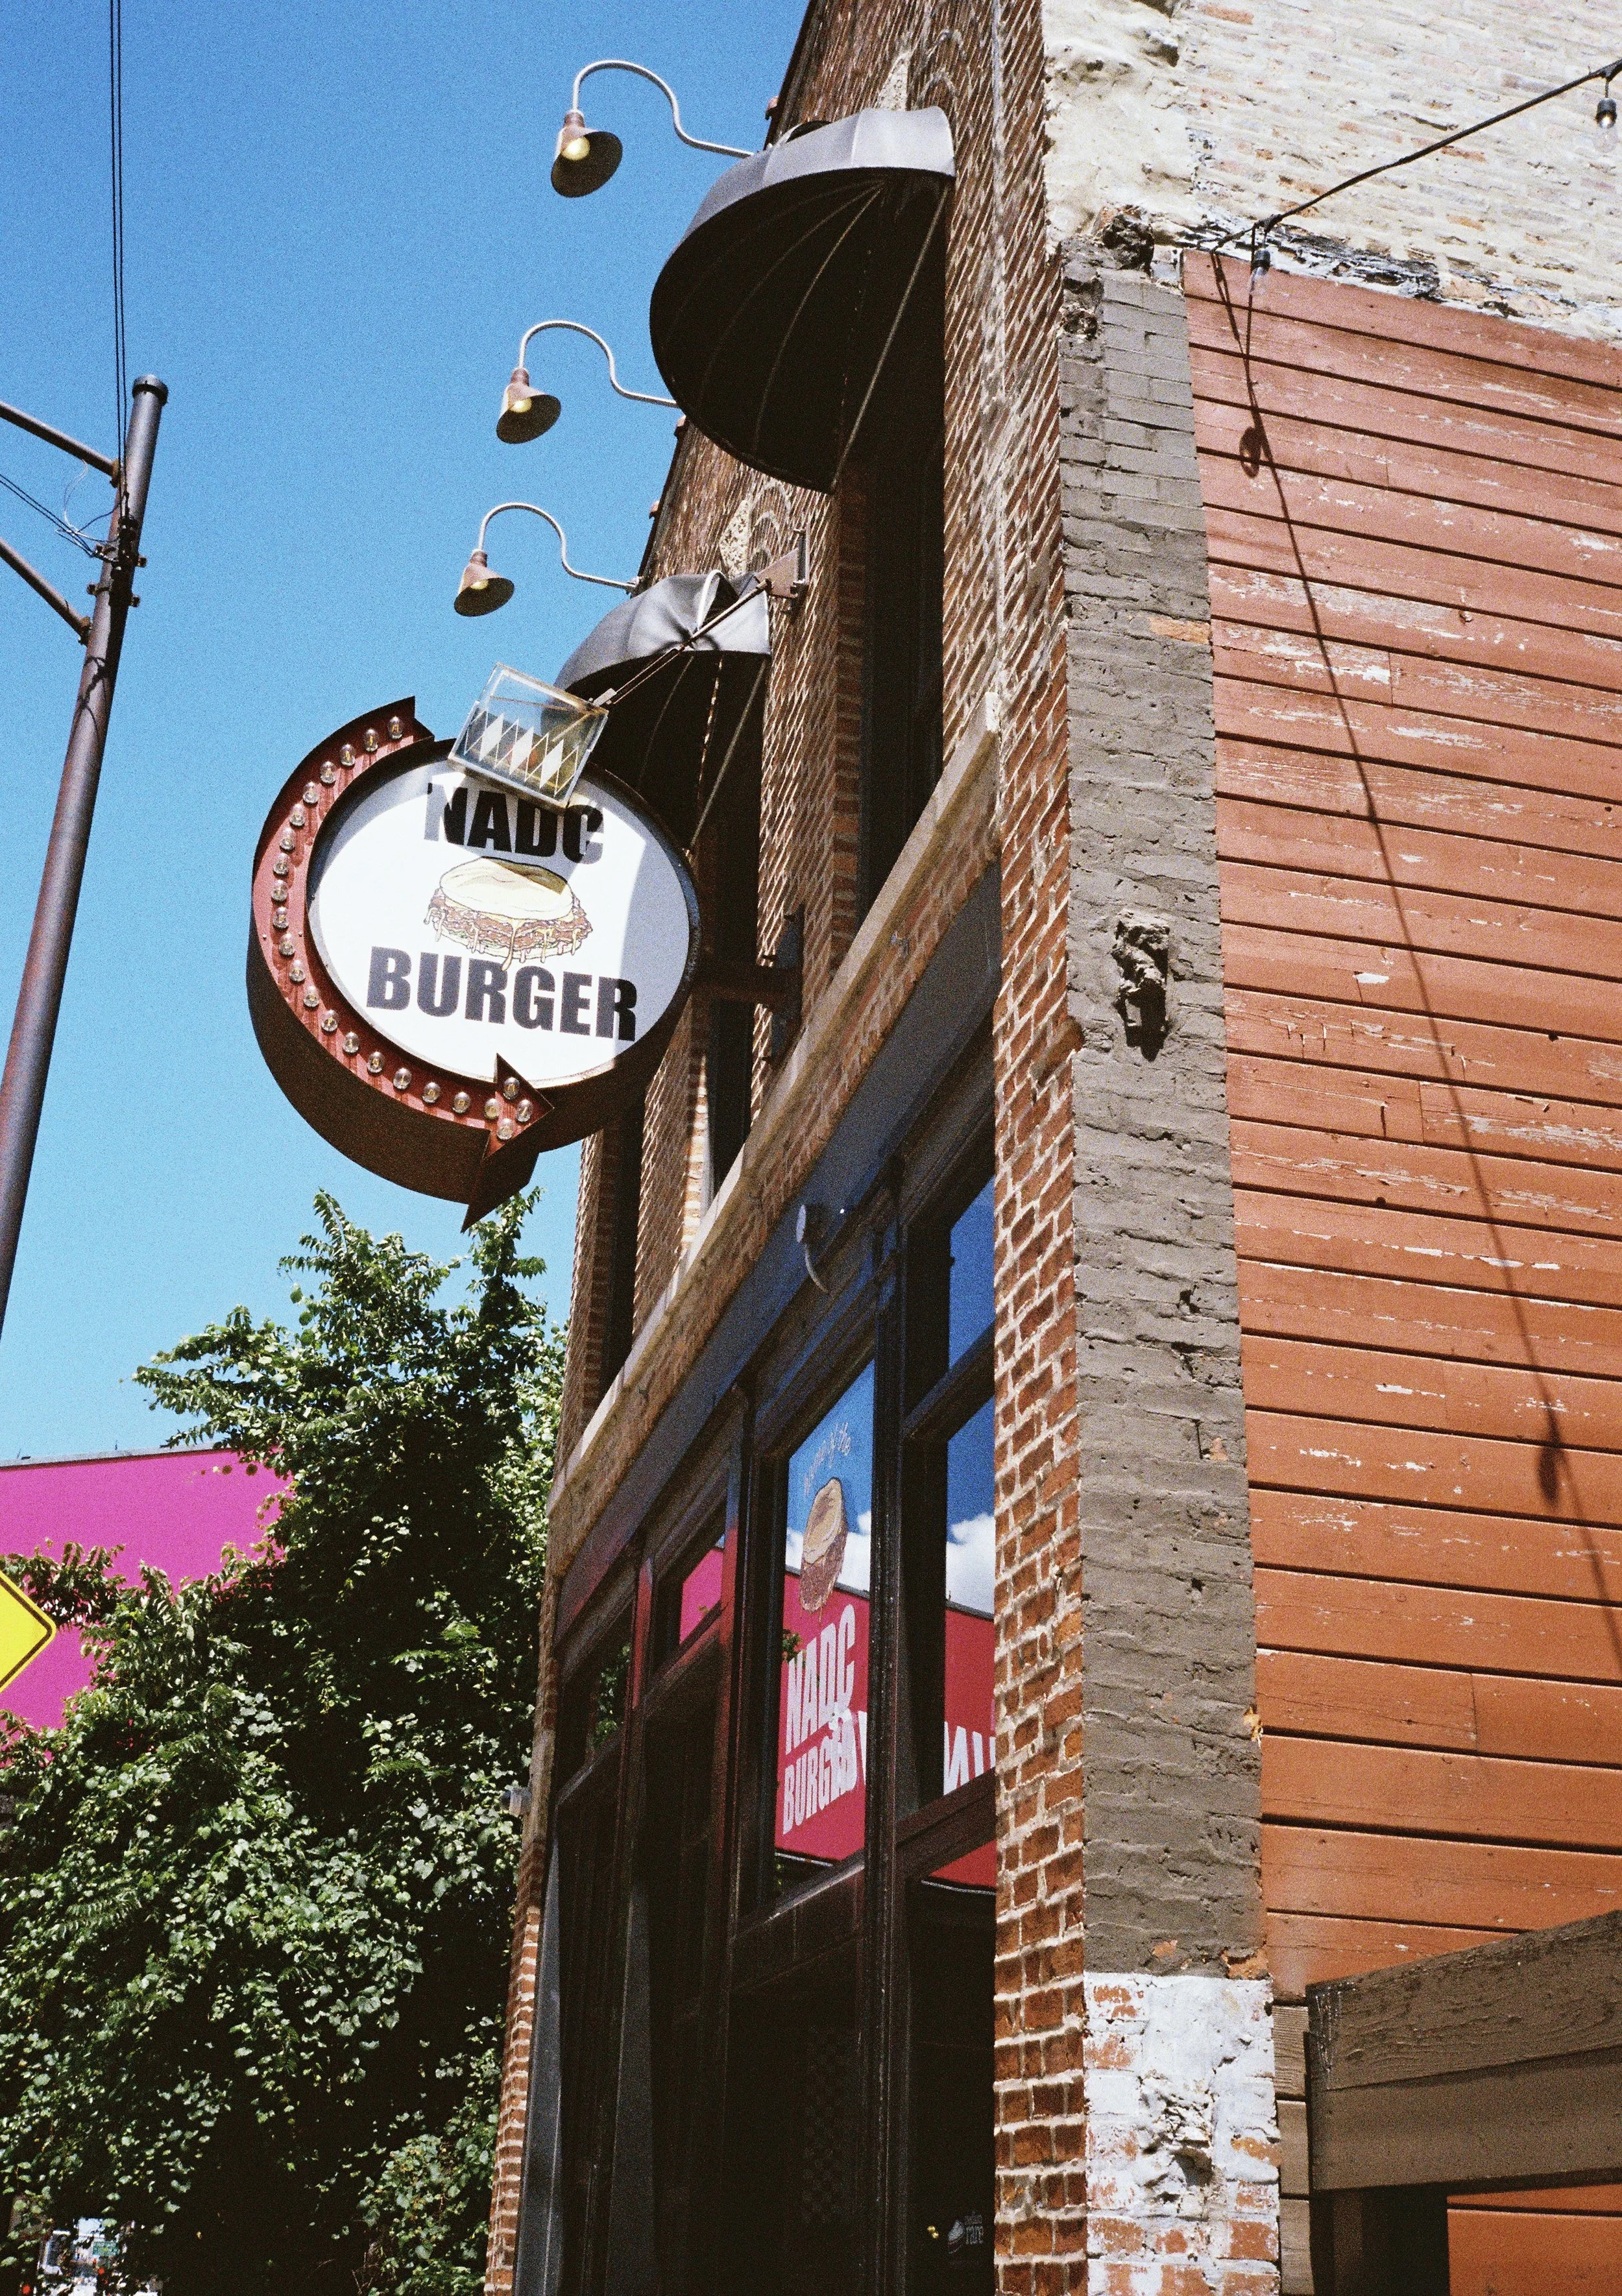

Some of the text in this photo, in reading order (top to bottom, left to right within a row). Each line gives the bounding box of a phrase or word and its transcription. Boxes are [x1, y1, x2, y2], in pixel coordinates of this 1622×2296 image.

[424, 782, 604, 864] NADC
[366, 947, 636, 1041] BURGER
[785, 1604, 855, 1755] NADC
